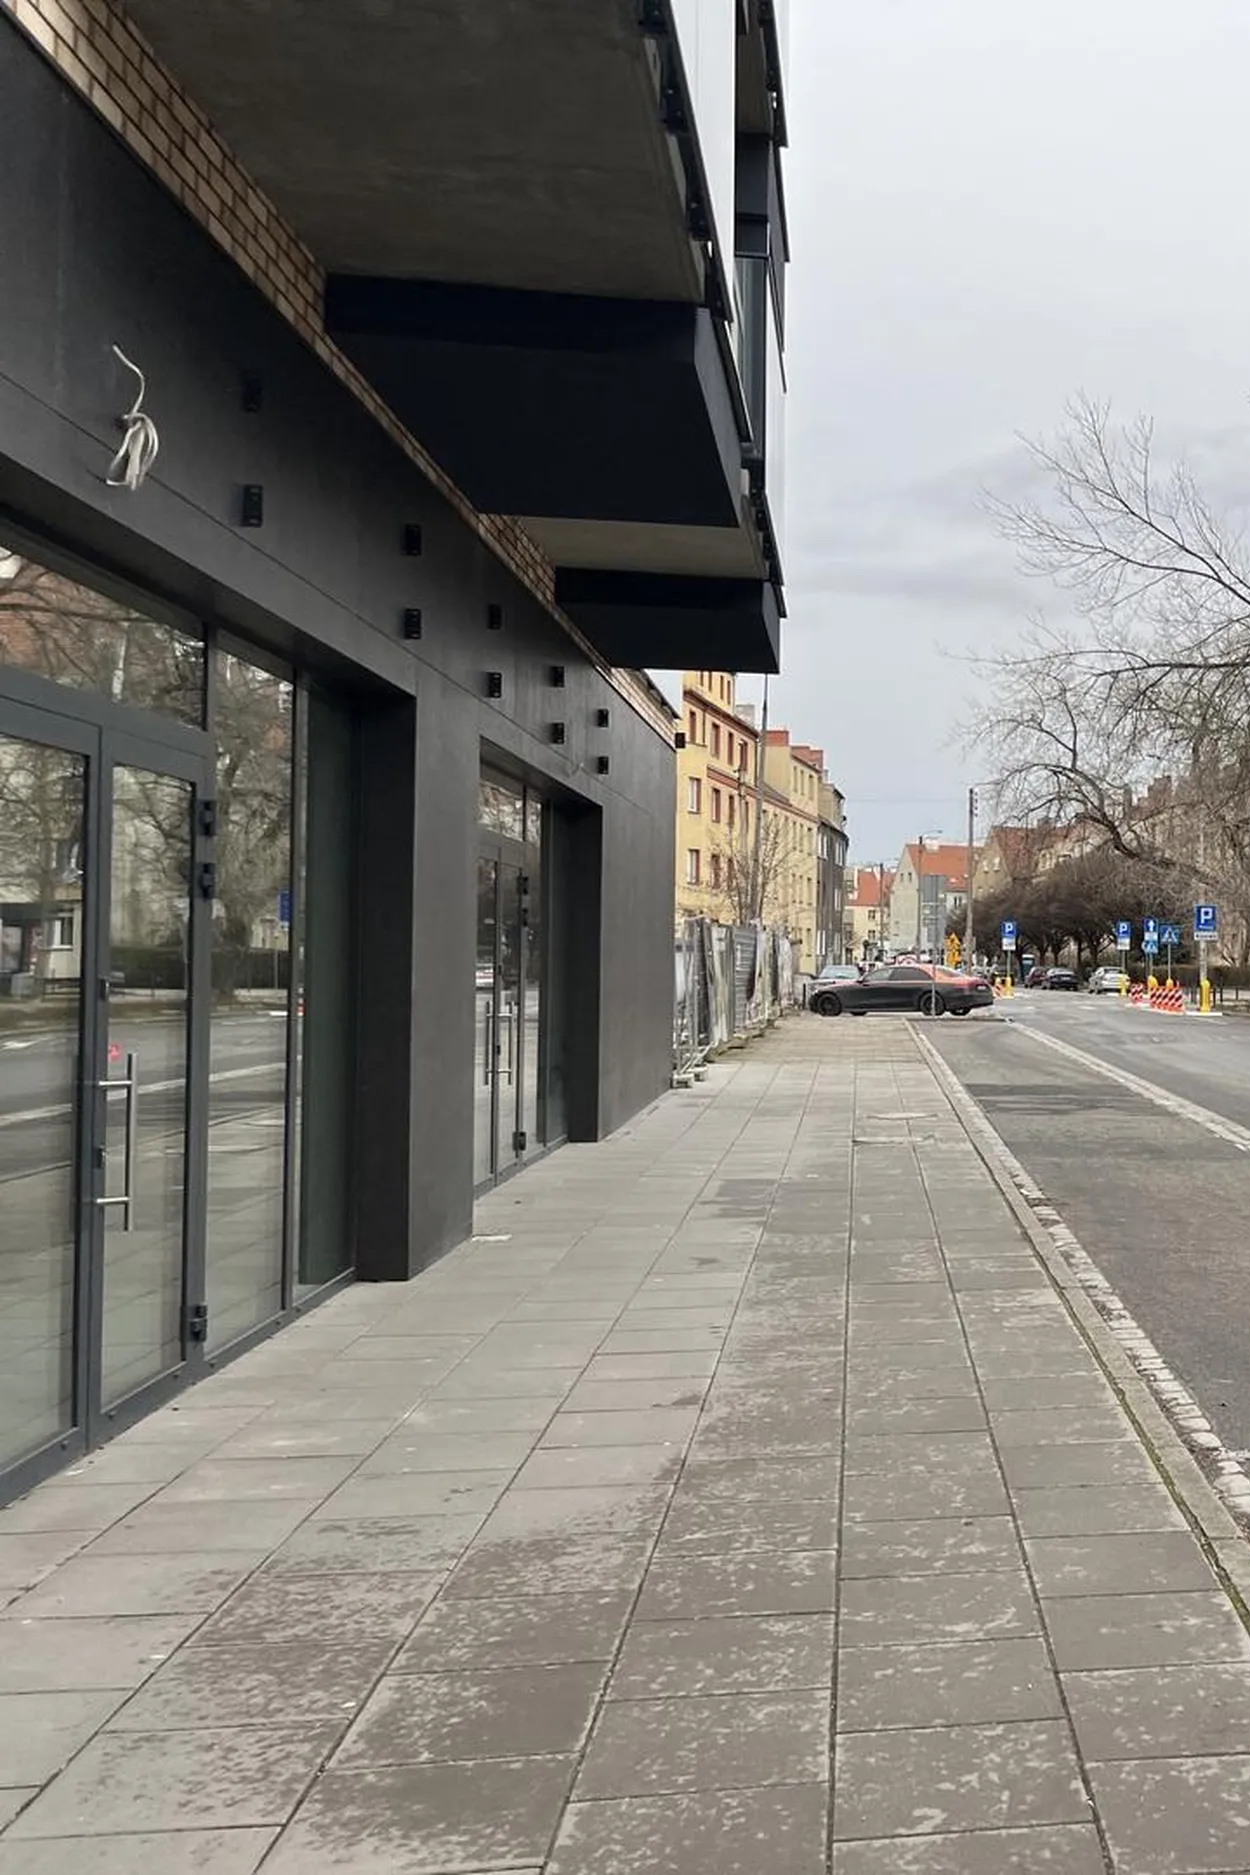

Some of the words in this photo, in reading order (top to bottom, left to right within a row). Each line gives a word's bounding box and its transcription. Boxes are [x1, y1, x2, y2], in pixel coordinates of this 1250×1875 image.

[1201, 907, 1212, 924] P
[1005, 922, 1013, 934] P
[1119, 923, 1128, 934] P
